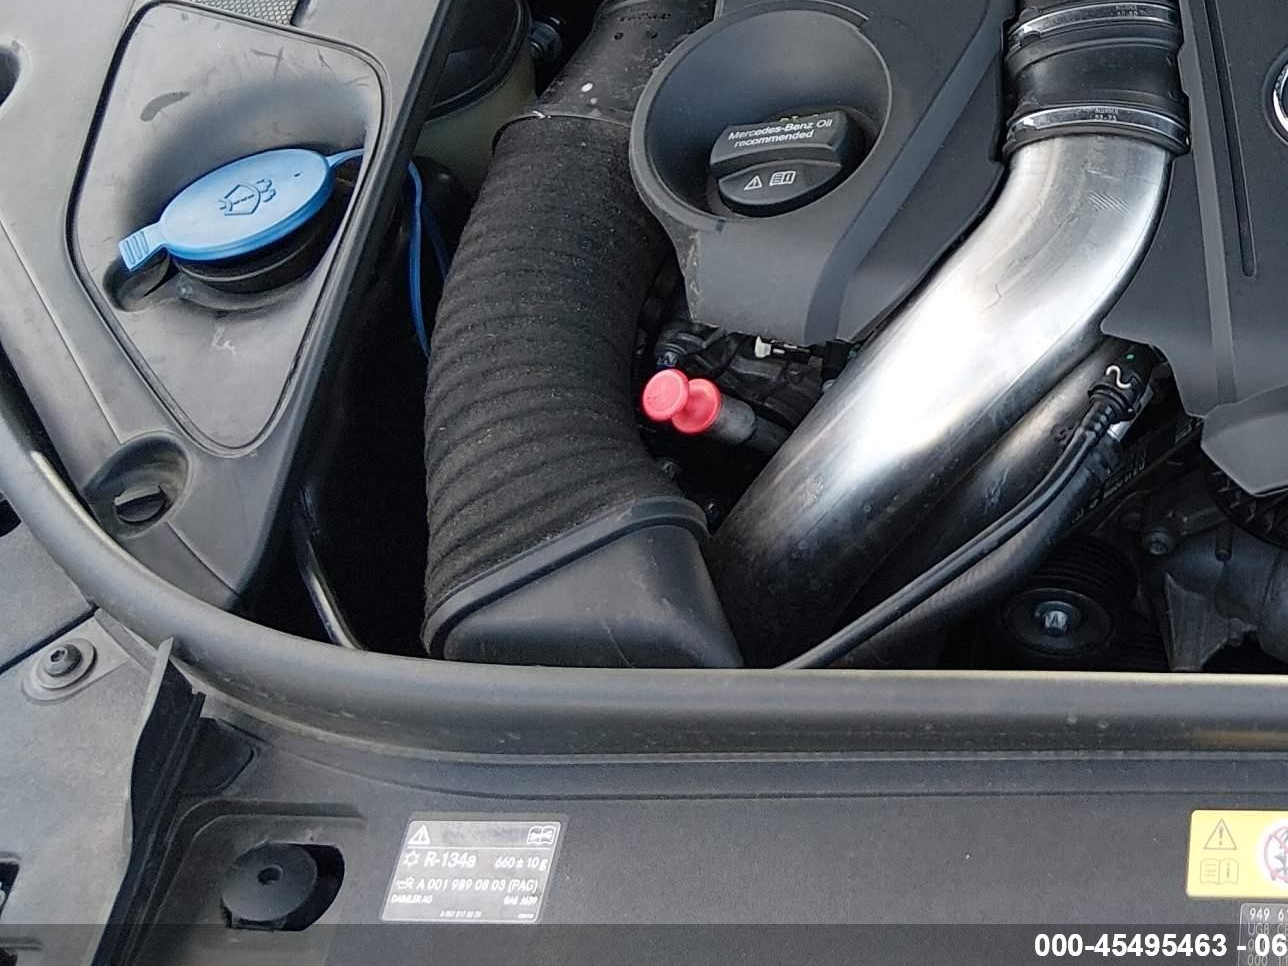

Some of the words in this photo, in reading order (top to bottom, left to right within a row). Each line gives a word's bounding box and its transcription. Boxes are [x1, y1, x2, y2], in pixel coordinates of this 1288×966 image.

[728, 122, 814, 141] Mercedes-Benz
[816, 118, 833, 129] Oil
[734, 130, 815, 148] recommended
[424, 851, 477, 868] R-134a
[495, 856, 515, 868] 660
[527, 857, 539, 868] 10
[539, 858, 548, 871] g
[416, 880, 425, 890] A
[427, 878, 449, 891] 001
[451, 879, 473, 891] 989
[474, 879, 490, 891] 08
[507, 879, 538, 893] (PAG)
[1249, 907, 1270, 921] 949
